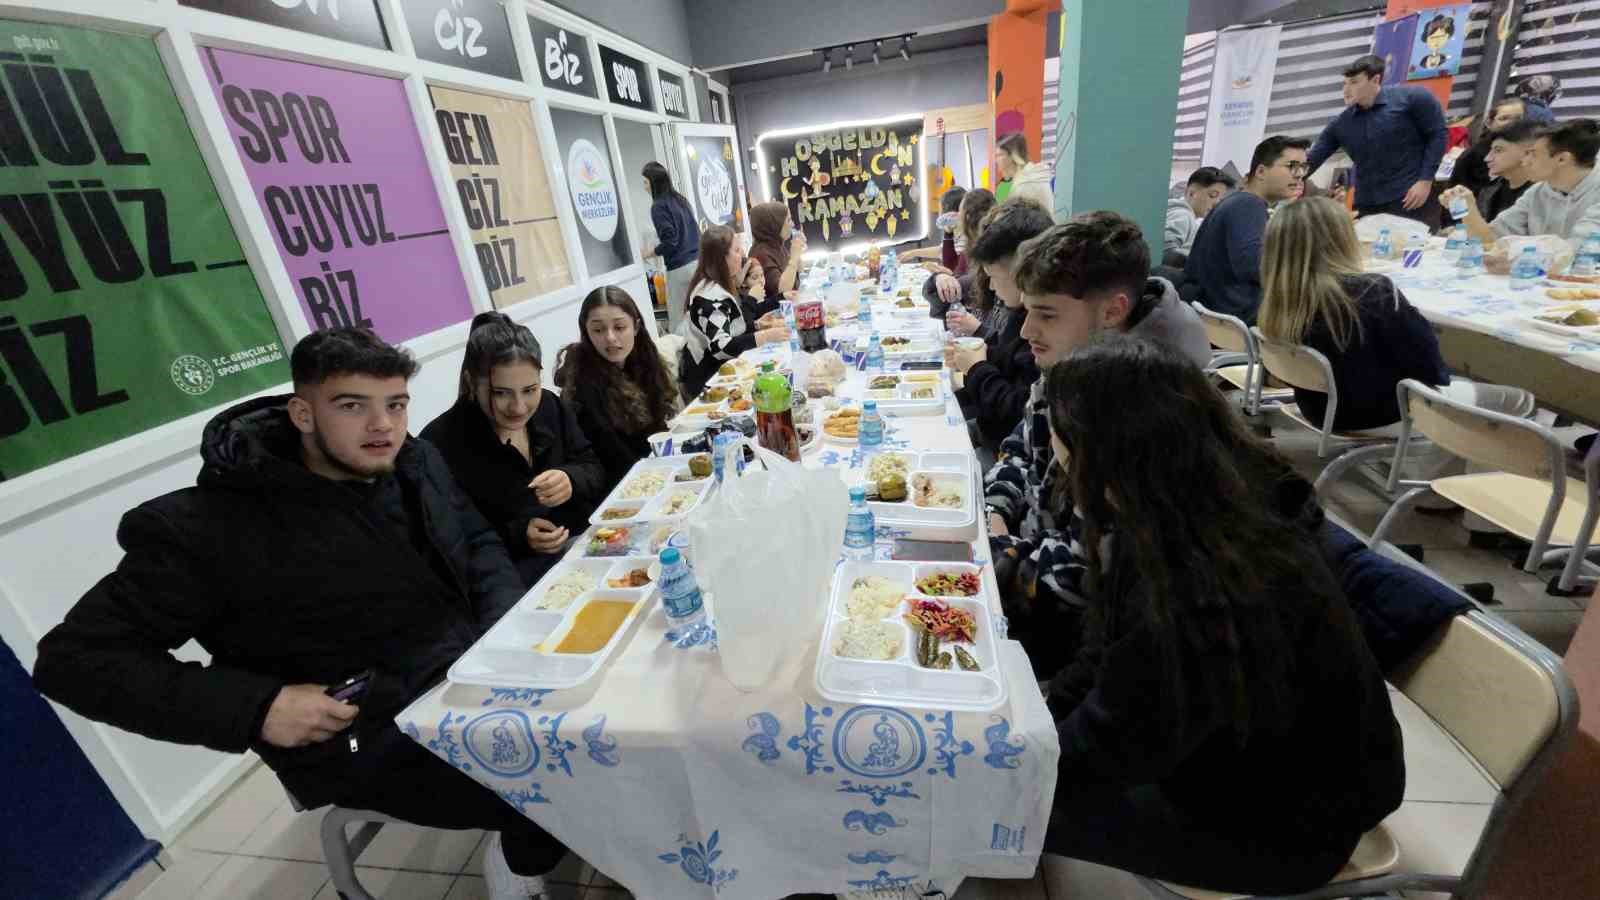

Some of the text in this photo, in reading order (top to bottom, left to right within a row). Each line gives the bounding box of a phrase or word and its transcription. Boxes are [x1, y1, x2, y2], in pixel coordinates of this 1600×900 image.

[612, 62, 642, 103] SPOR
[222, 84, 352, 164] SPOR
[436, 109, 499, 166] GEN
[264, 183, 395, 257] CUYUZ
[457, 173, 510, 230] CİZ
[798, 187, 903, 224] RAMAZAN
[474, 235, 525, 292] BİZ
[299, 261, 373, 331] BİZ
[217, 364, 240, 376] SPOR
